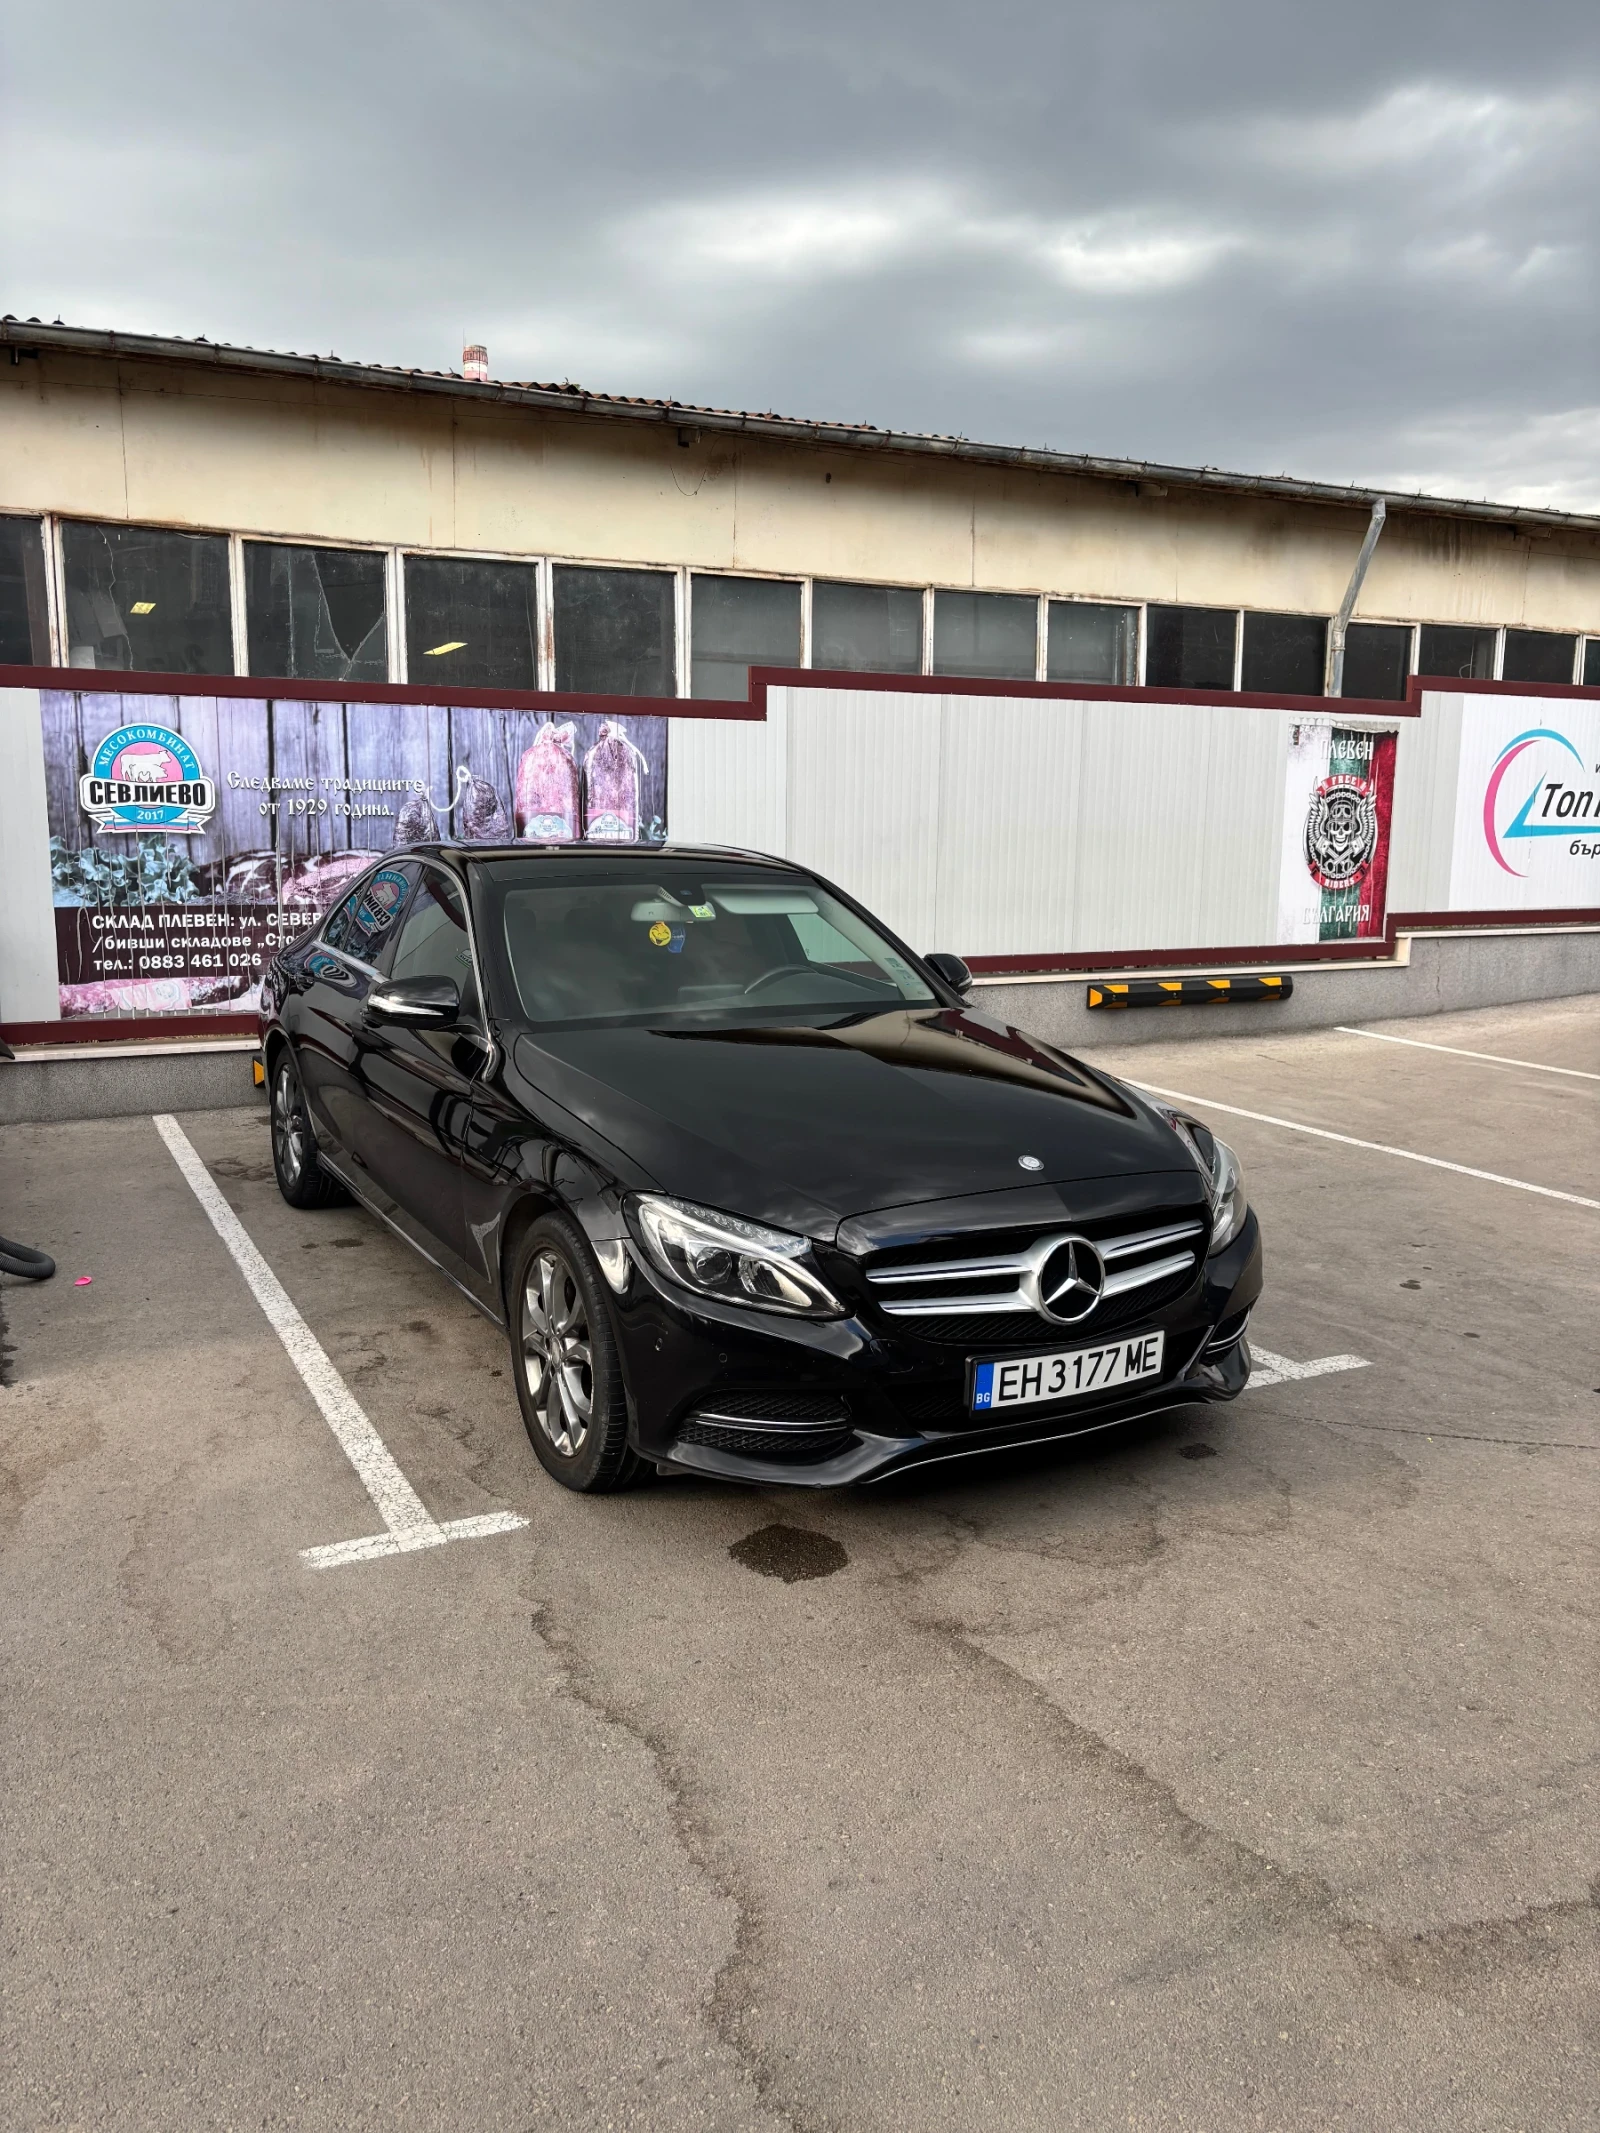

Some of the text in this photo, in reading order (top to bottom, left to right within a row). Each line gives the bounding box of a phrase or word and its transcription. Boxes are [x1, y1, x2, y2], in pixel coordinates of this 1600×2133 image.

[98, 728, 196, 769] МЕСОКОМБИНАТ
[227, 770, 426, 795] Следваме традициите
[89, 780, 206, 807] СЕВЛИЕВО
[136, 810, 165, 820] 2017
[259, 798, 395, 819] от 1929 година.
[92, 914, 154, 930] СКЛАД
[158, 913, 235, 928] ПЛЕВЕН:
[239, 916, 262, 930] ул.
[171, 936, 252, 950] складове
[94, 953, 262, 971] тел.: 0883 461 026
[1048, 1346, 1121, 1393] 3177
[1124, 1337, 1159, 1377] ME
[976, 1392, 991, 1404] BG
